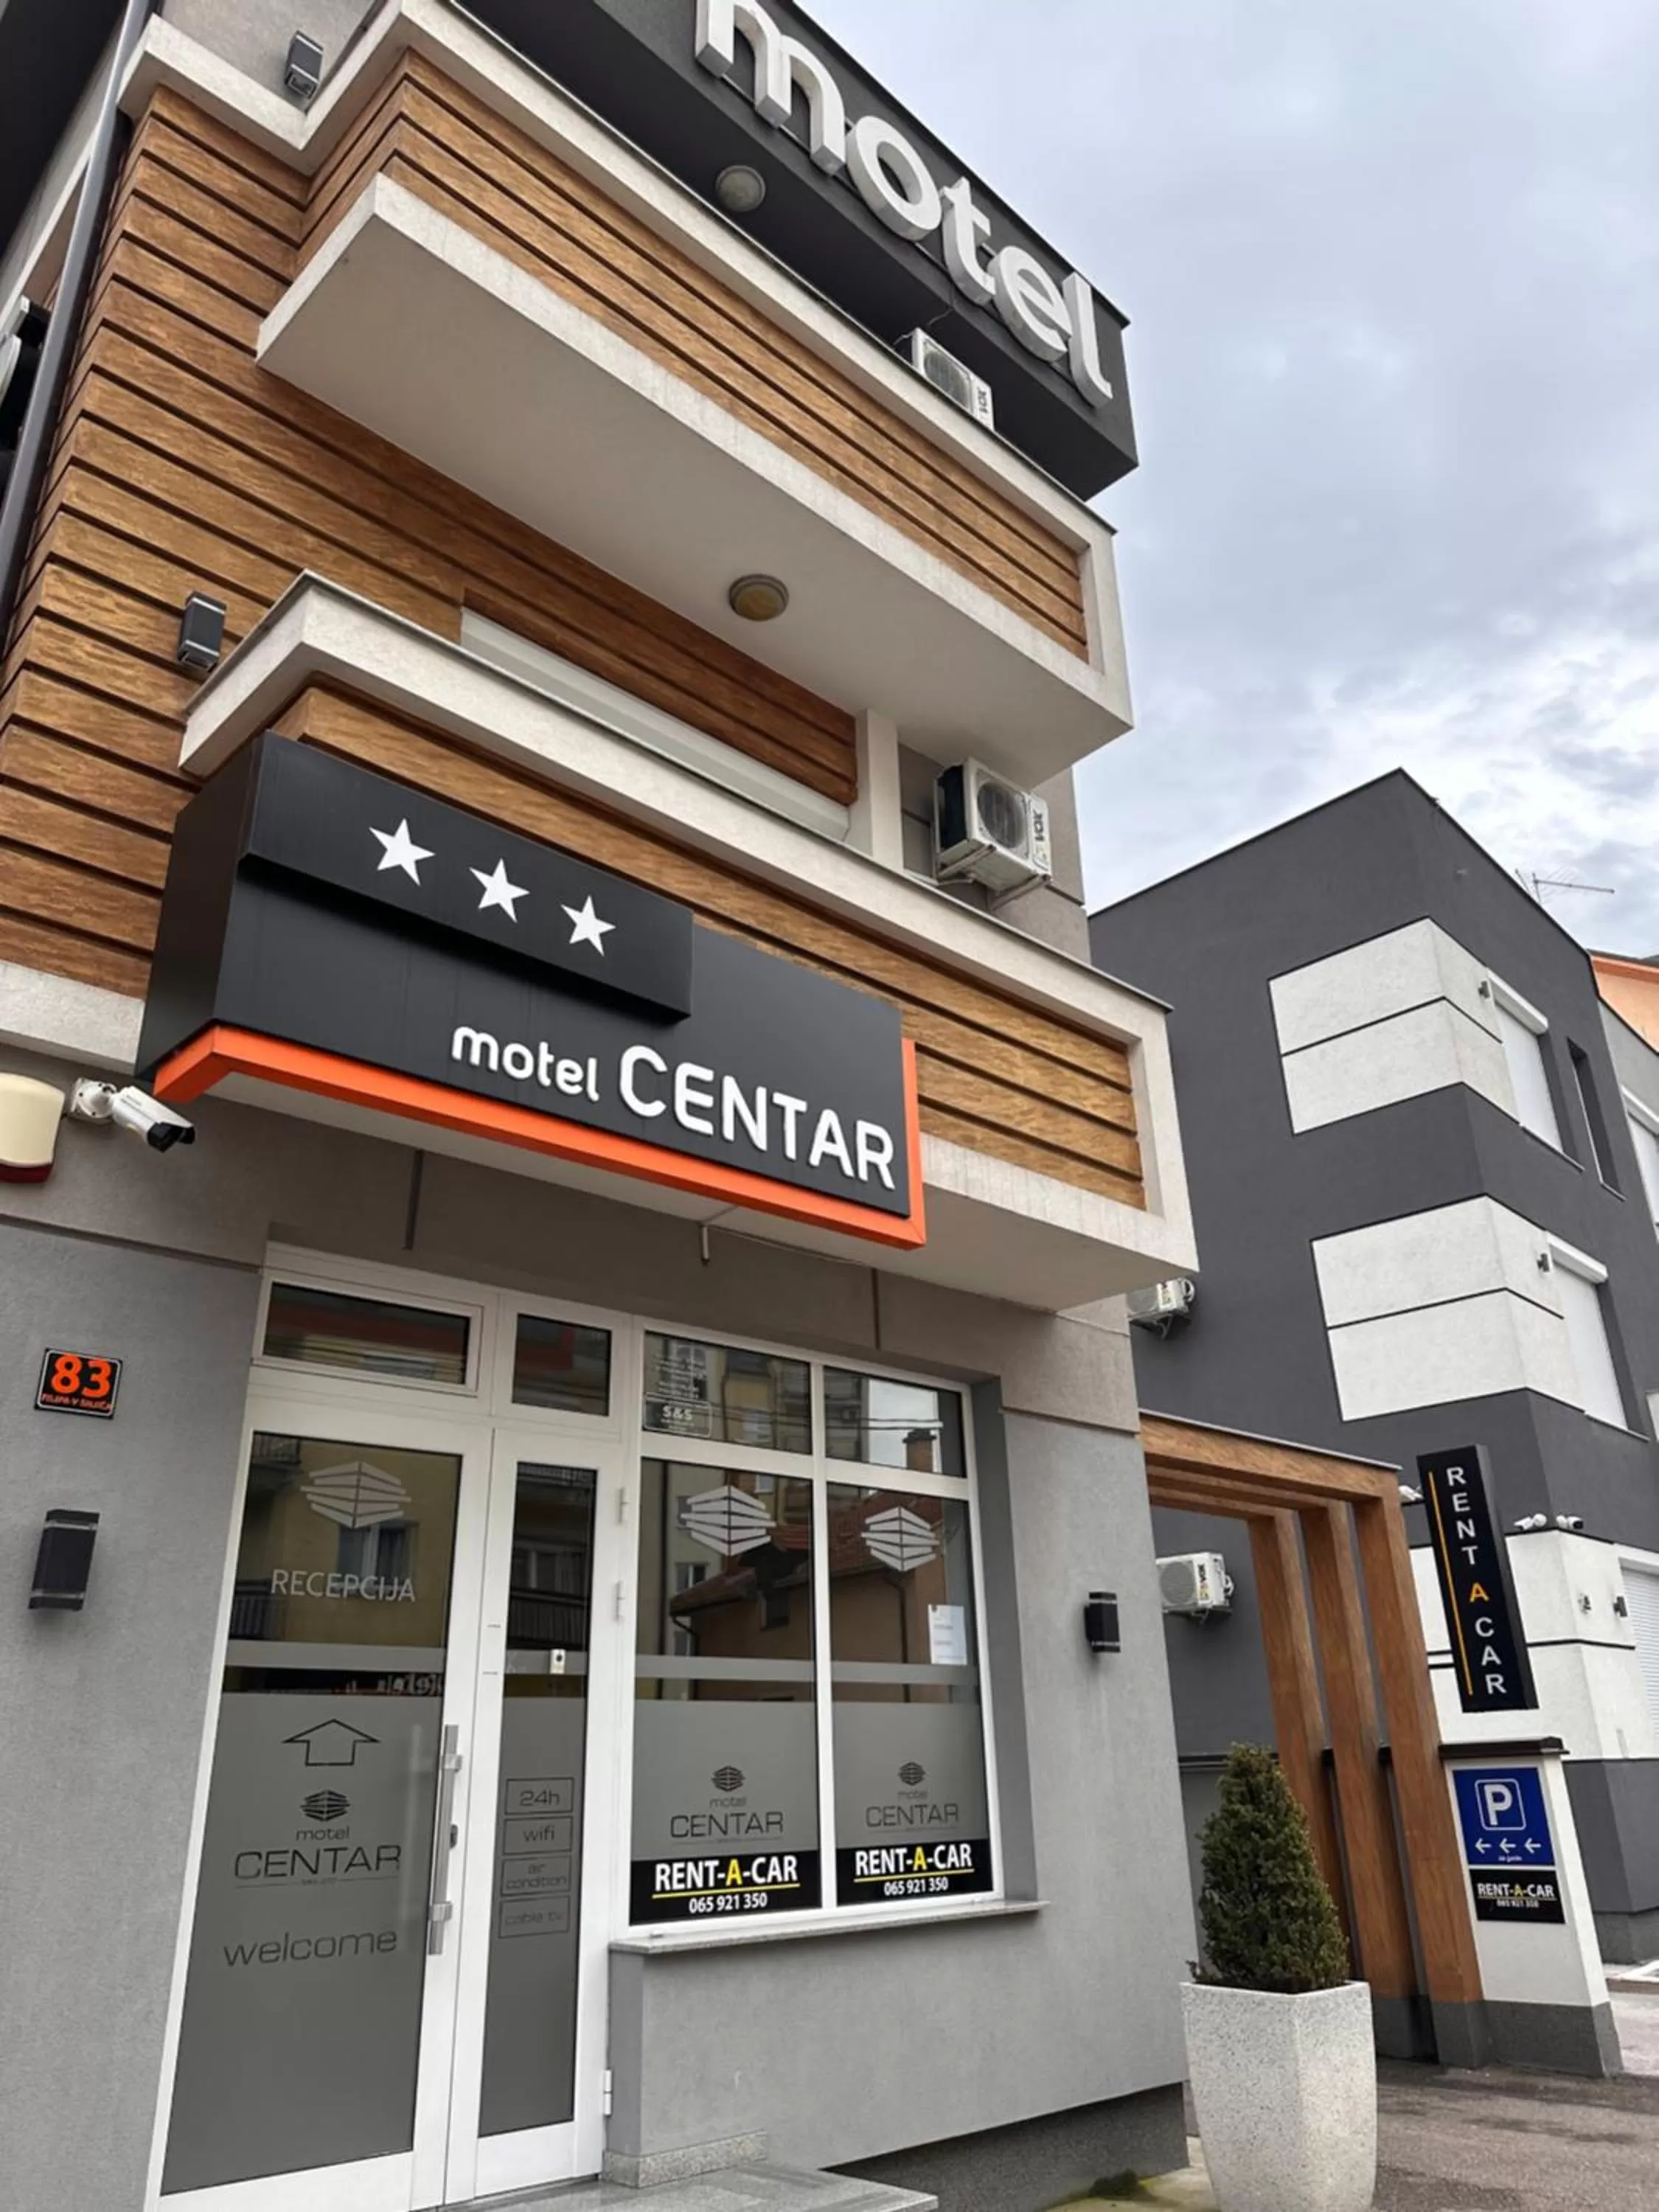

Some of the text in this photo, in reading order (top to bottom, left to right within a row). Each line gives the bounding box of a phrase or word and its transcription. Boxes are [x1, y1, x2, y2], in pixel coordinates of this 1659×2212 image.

[695, 0, 1113, 410] motel
[451, 1026, 895, 1189] motel CENTAR
[51, 1353, 111, 1398] 83
[271, 1568, 416, 1603] RECEPCIJA
[1446, 1466, 1507, 1694] RENT A CAR
[518, 1790, 560, 1806] 24h
[670, 1811, 784, 1838] CENTAR
[866, 1803, 959, 1828] CENTAR
[296, 1826, 350, 1841] motel
[522, 1825, 556, 1842] wifi
[234, 1845, 402, 1879] CENTAR
[655, 1854, 799, 1892] RENT-A-CAR
[855, 1843, 973, 1877] RENT-A-CAR
[689, 1892, 768, 1914] 065 921 350
[883, 1876, 949, 1897] 065 921 350
[1477, 1882, 1555, 1898] RENT-A-CAR
[223, 1930, 398, 1968] welcome
